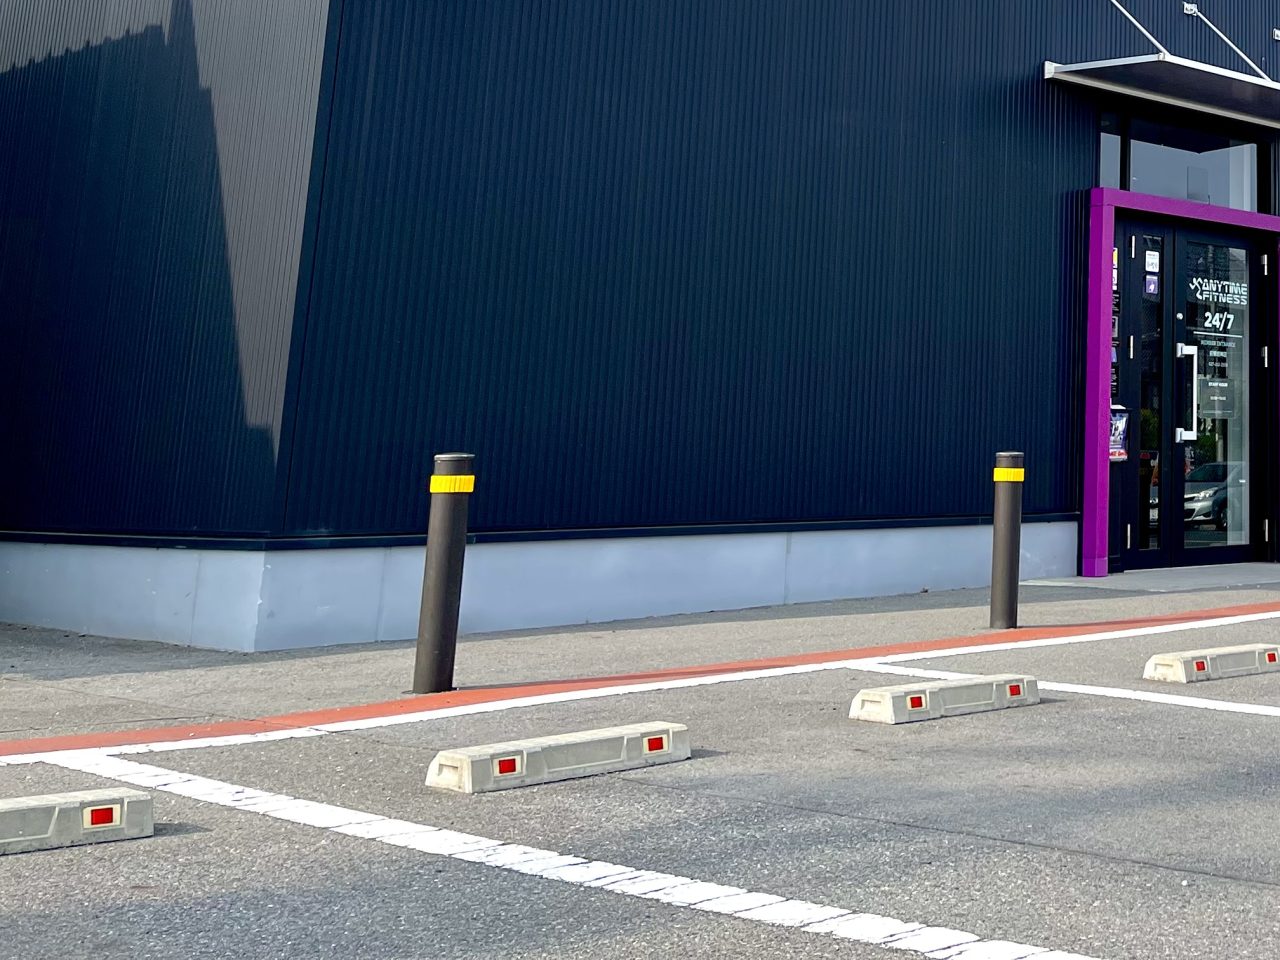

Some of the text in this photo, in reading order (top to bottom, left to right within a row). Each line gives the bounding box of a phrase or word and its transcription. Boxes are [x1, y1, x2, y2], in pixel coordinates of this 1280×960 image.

[1202, 278, 1247, 295] ANYTIME
[1202, 291, 1247, 305] FITNESS
[1203, 311, 1234, 331] 24/7
